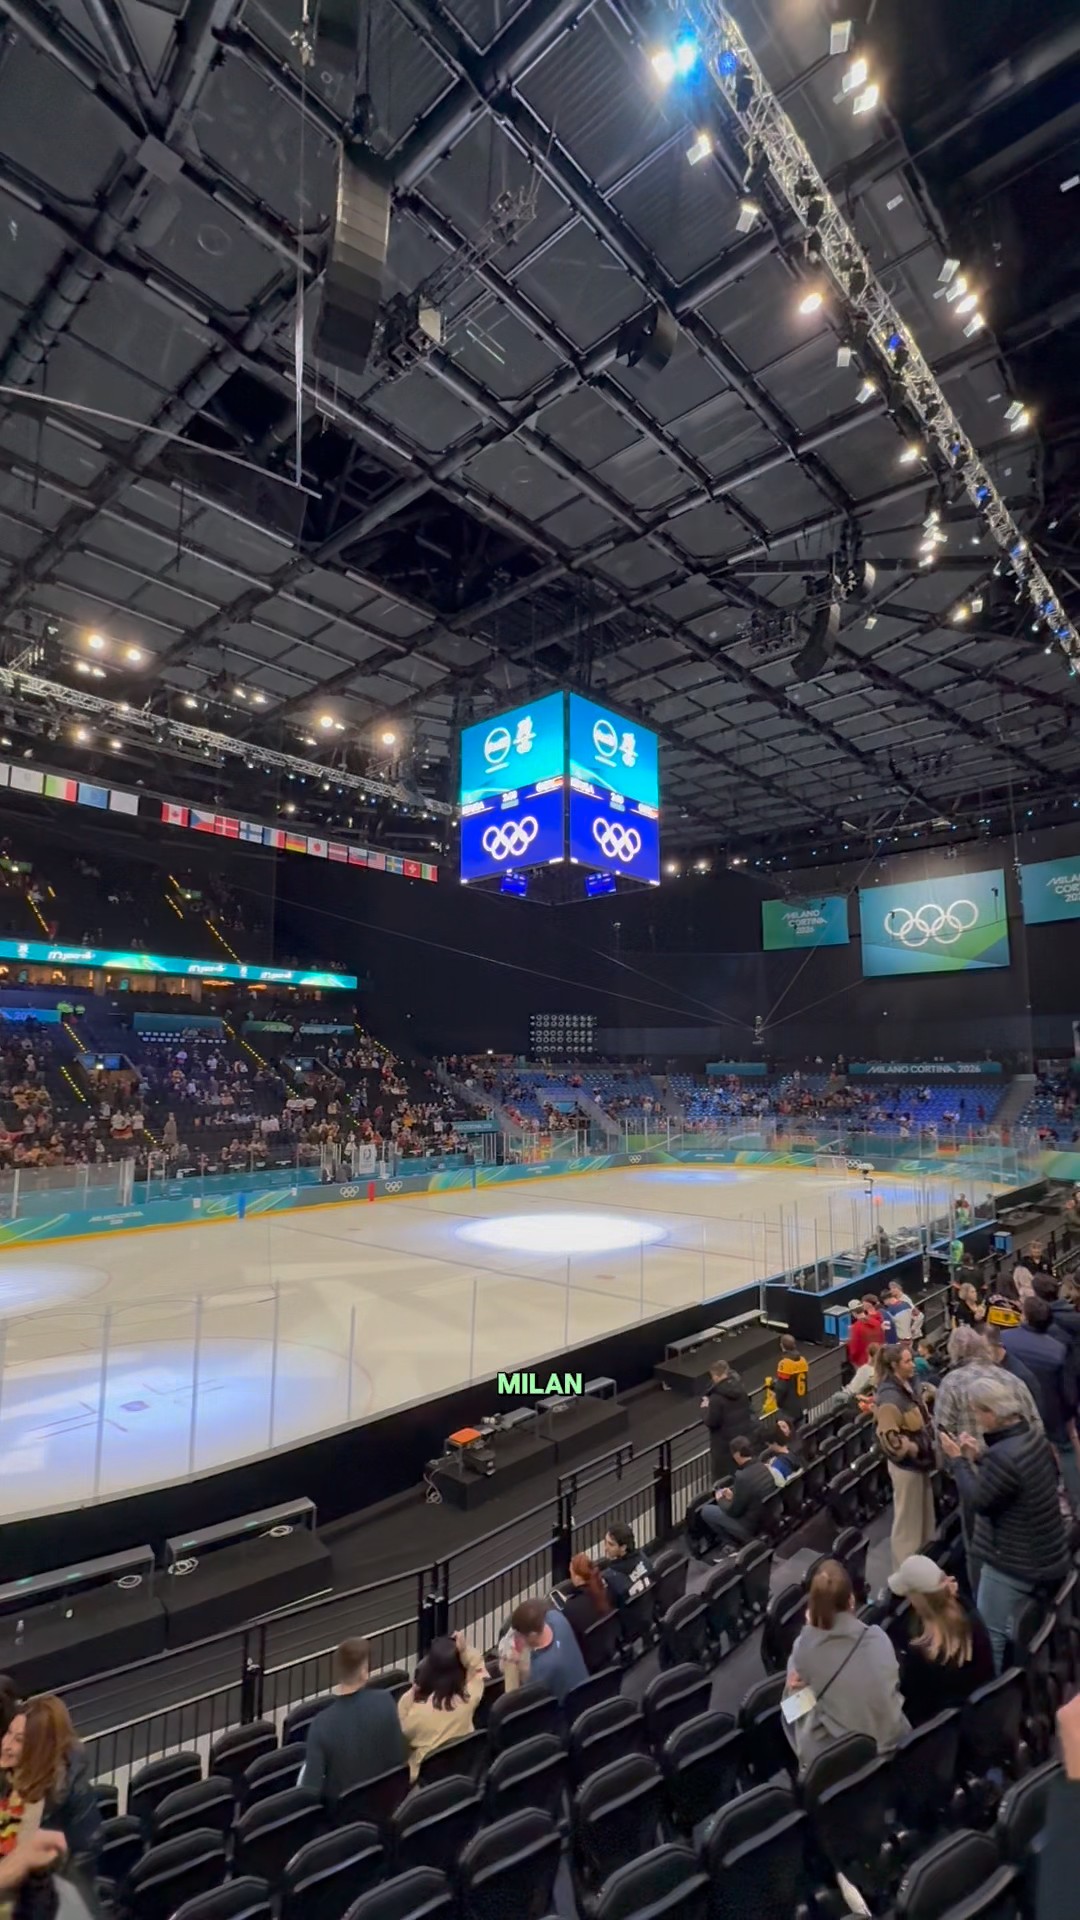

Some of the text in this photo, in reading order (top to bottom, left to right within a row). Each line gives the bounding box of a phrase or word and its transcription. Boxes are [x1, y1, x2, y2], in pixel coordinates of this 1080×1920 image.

[782, 909, 820, 920] MILANO
[788, 917, 828, 927] CORTINA
[867, 1065, 981, 1073] MILANO CORTINA 2026
[797, 1372, 806, 1396] 6
